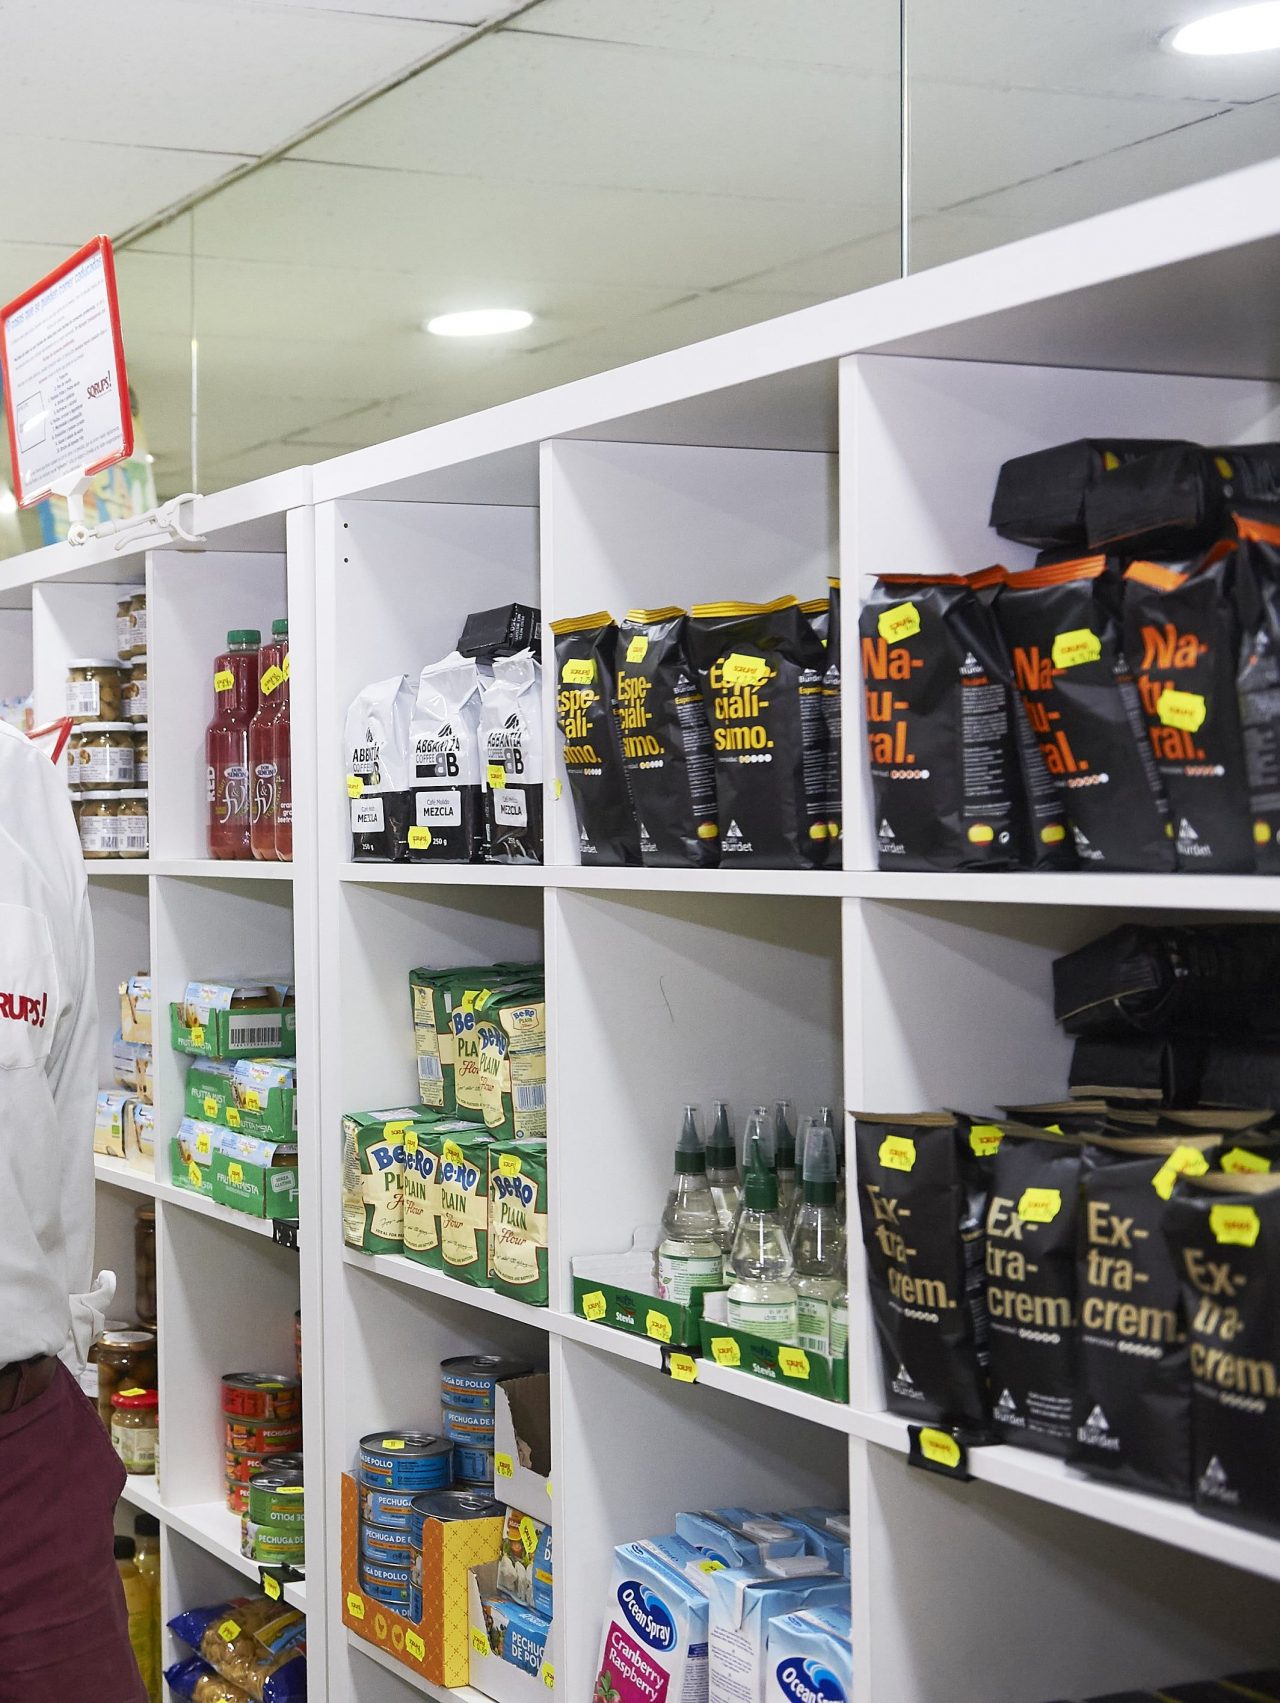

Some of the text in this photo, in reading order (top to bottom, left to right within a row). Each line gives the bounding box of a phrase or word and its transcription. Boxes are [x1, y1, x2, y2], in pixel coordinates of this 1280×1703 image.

[861, 637, 924, 680] Na-
[1141, 622, 1209, 670] Na-
[1013, 646, 1067, 691] Na-
[714, 722, 774, 750] simo.
[423, 807, 454, 817] MEZCLA
[722, 840, 753, 852] Burdet
[404, 1176, 426, 1200] PLAIN
[441, 1187, 467, 1213] PLAIN
[501, 1202, 527, 1231] PLAIN
[987, 1196, 1039, 1240] Ex-
[1087, 1200, 1150, 1249] Ex-
[500, 1228, 526, 1245] Flour
[985, 1240, 1038, 1281] tra-
[1087, 1248, 1150, 1292] tra-
[1183, 1247, 1247, 1296] Ex-
[615, 1311, 635, 1325] Stevia
[987, 1286, 1078, 1328] crem.
[1082, 1296, 1186, 1342] crem.
[752, 1362, 777, 1378] Stevia
[465, 1380, 491, 1389] POLLO
[448, 1413, 479, 1425] PECHUGA
[371, 1457, 393, 1468] POLLO
[258, 1534, 294, 1544] PECHUGA
[366, 1529, 395, 1543] PECHUGA
[382, 1570, 407, 1581] POLLO
[622, 1588, 671, 1646] Ocean Spray
[511, 1645, 523, 1661] DE
[611, 1631, 664, 1689] Cranberry
[609, 1647, 658, 1702] Raspberry
